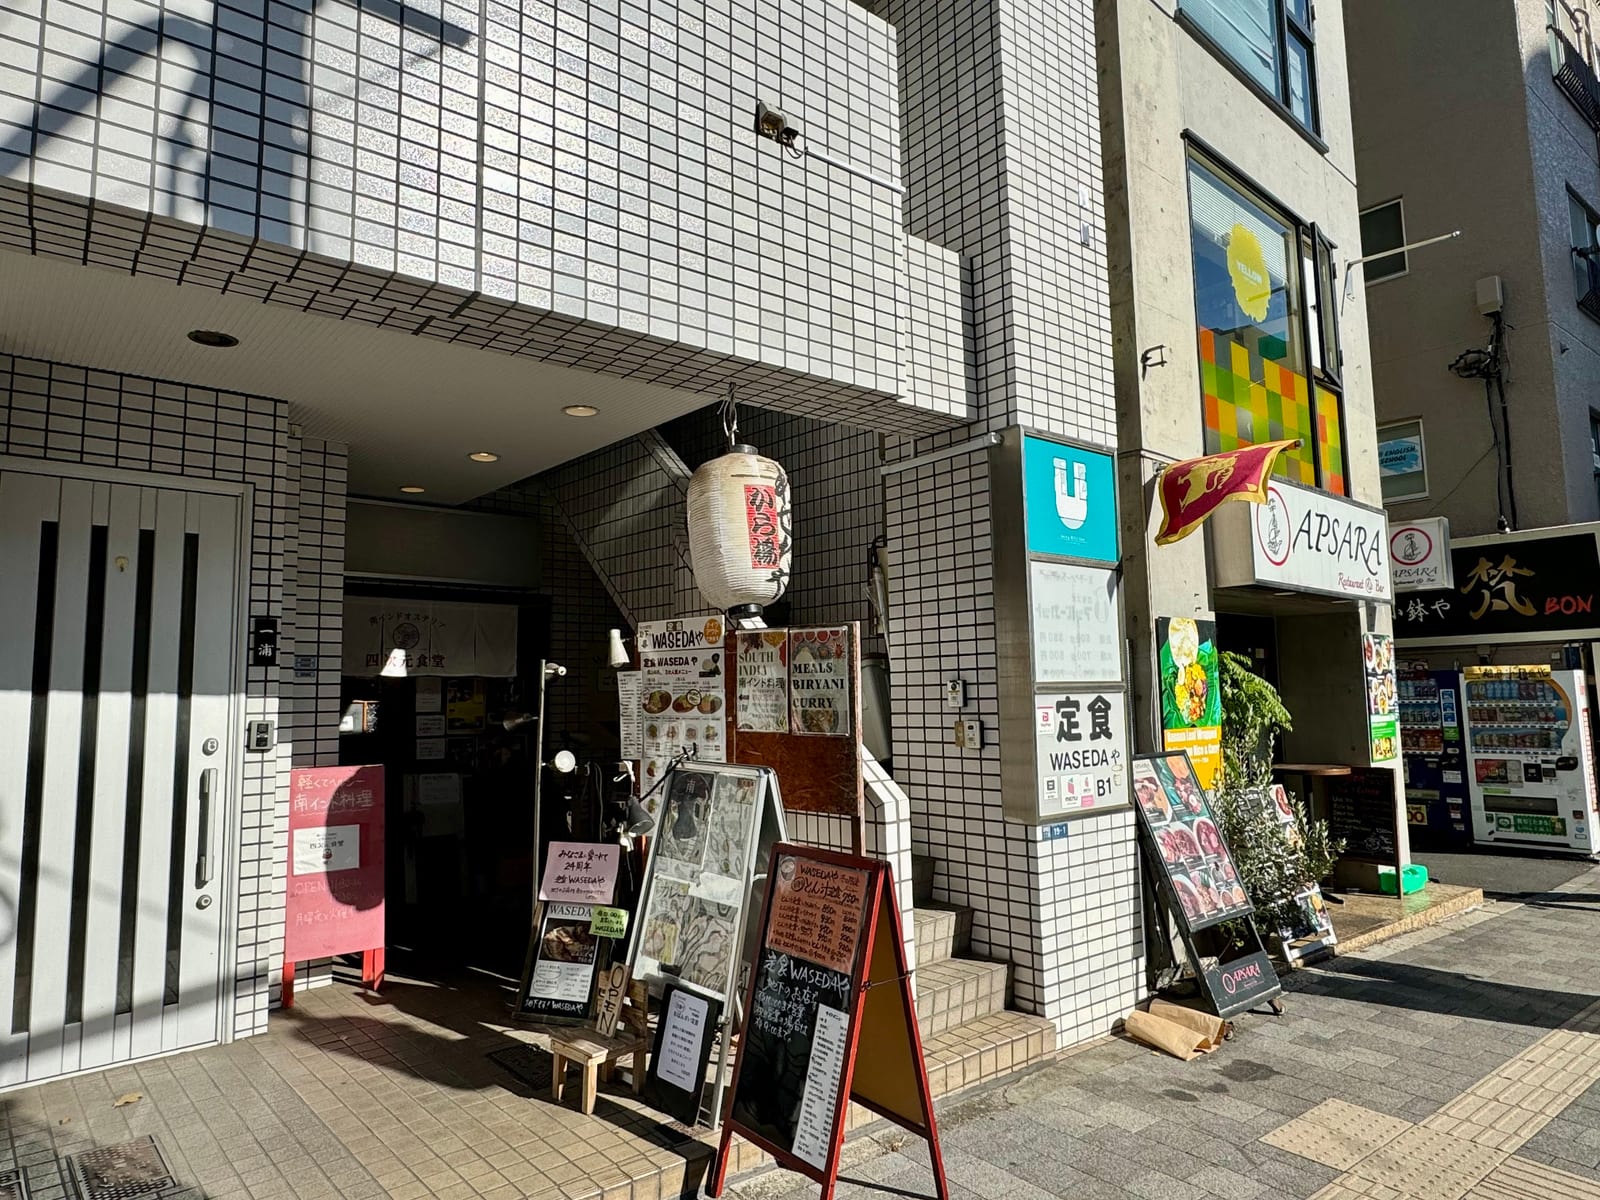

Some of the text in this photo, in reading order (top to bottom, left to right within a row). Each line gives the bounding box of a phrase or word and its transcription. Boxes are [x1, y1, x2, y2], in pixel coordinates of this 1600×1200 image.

[1236, 260, 1262, 284] YELLOW
[1385, 445, 1415, 456] ENGLISH
[1381, 454, 1406, 464] SCHOOL
[1293, 508, 1382, 576] APSARA
[1461, 554, 1593, 620] 梵 BON
[657, 656, 690, 667] WASEDA
[739, 652, 773, 662] SOUTH
[792, 662, 832, 674] MEALS
[793, 679, 844, 690] BIRYANI
[793, 697, 833, 709] CURRY
[1056, 695, 1113, 742] 定食
[1097, 777, 1112, 797] B1
[600, 965, 625, 1035] OPEN
